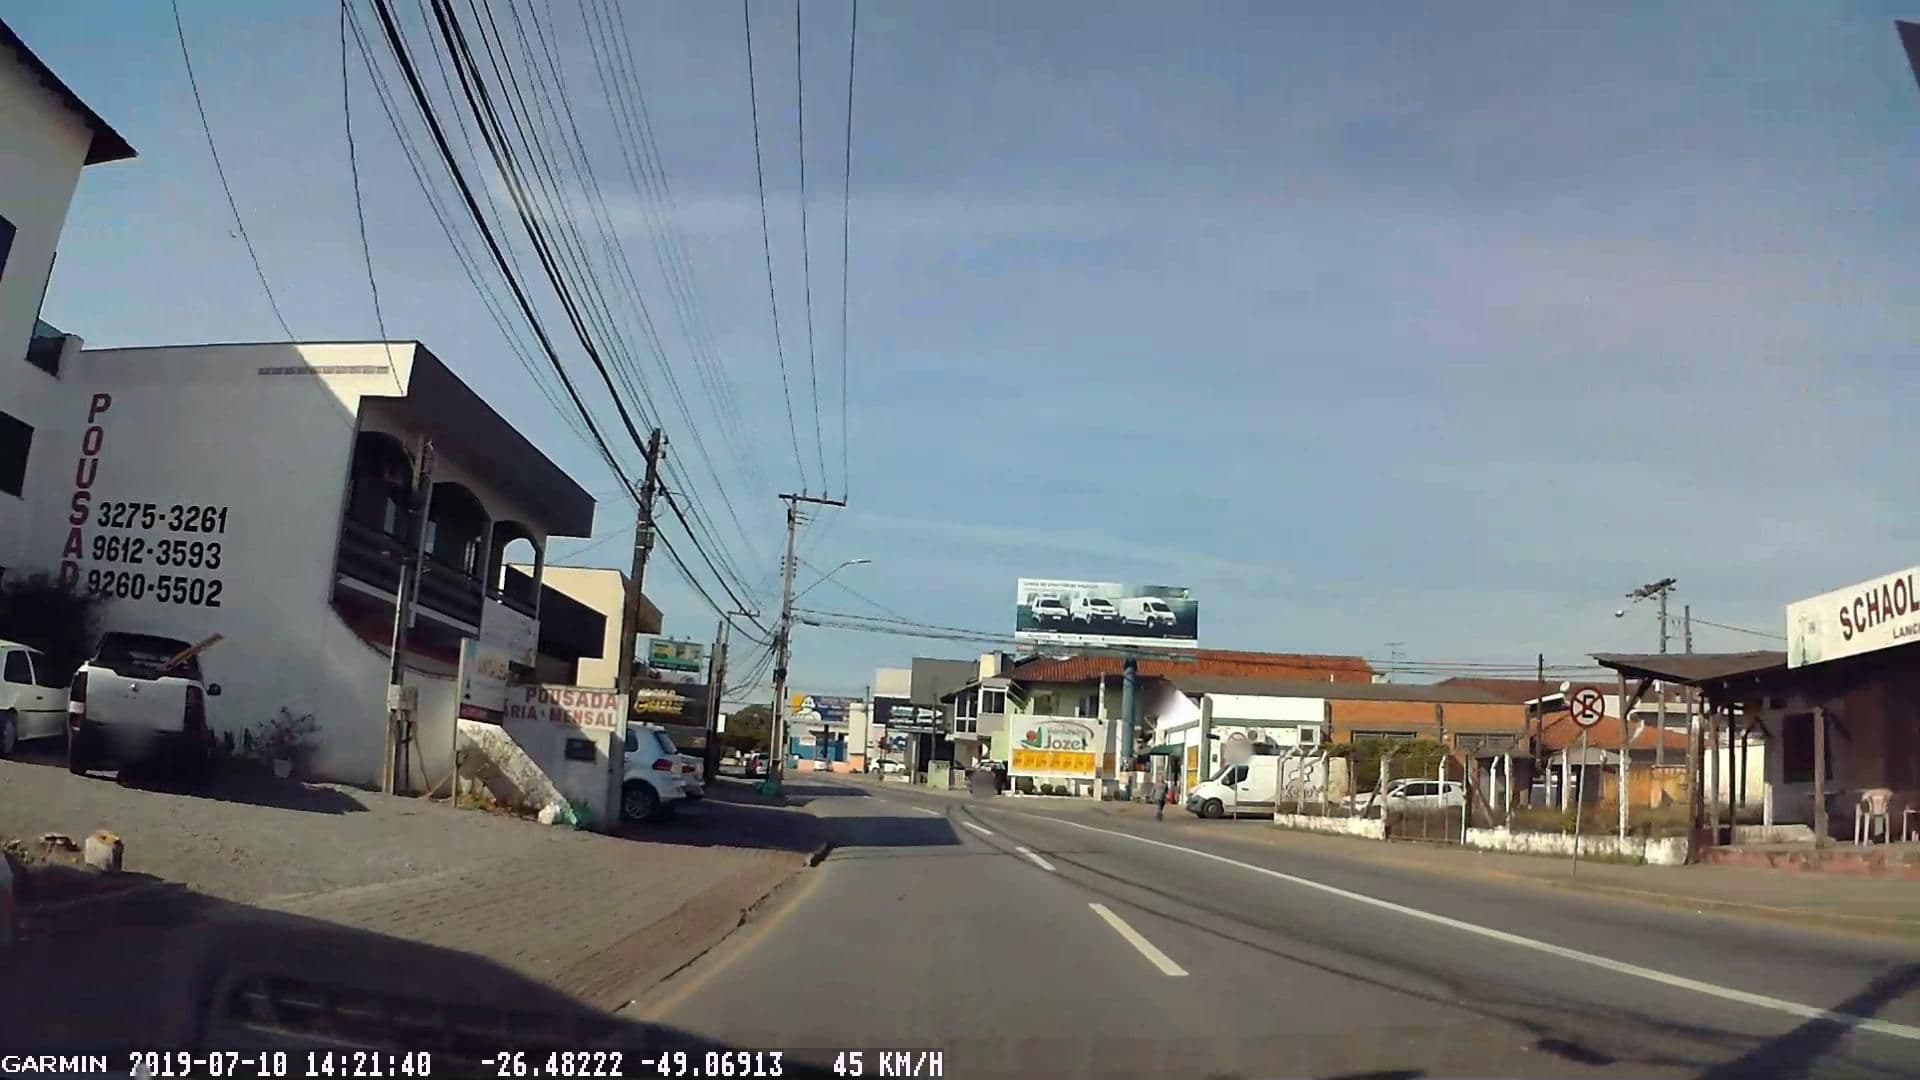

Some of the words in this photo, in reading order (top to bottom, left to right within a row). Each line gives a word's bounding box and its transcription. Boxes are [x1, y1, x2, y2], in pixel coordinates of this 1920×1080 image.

[97, 501, 228, 534] 3275-3261
[92, 534, 222, 570] 9612-3593
[87, 569, 224, 608] 9260-5502
[1892, 622, 1920, 640] LANC
[525, 687, 618, 710] POUSADA
[549, 706, 617, 728] MENSAL
